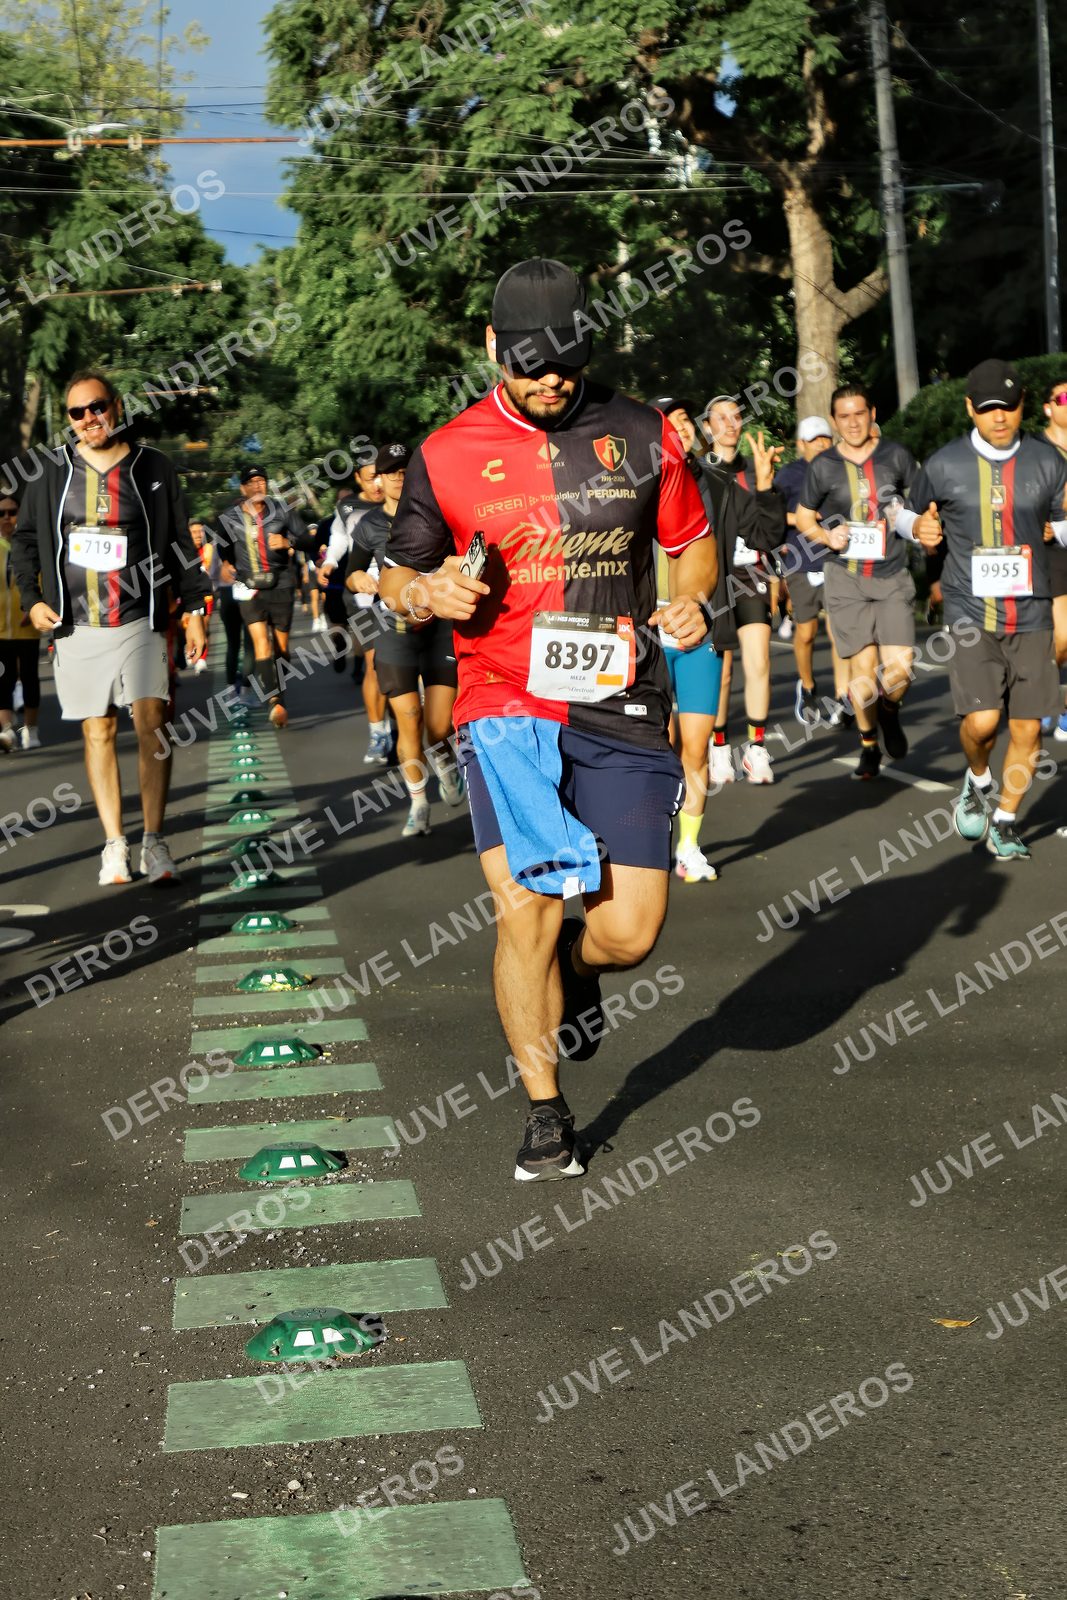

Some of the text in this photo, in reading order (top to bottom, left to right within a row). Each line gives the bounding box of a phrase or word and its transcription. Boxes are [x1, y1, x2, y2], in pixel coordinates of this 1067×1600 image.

[540, 491, 580, 502] Totalplay
[587, 488, 637, 499] PERDURA
[477, 498, 523, 518] URREA
[85, 539, 112, 554] 719
[498, 522, 634, 566] Caliente
[508, 561, 629, 585] caliente.mx
[981, 562, 1019, 578] 9955
[545, 640, 615, 672] 8397
